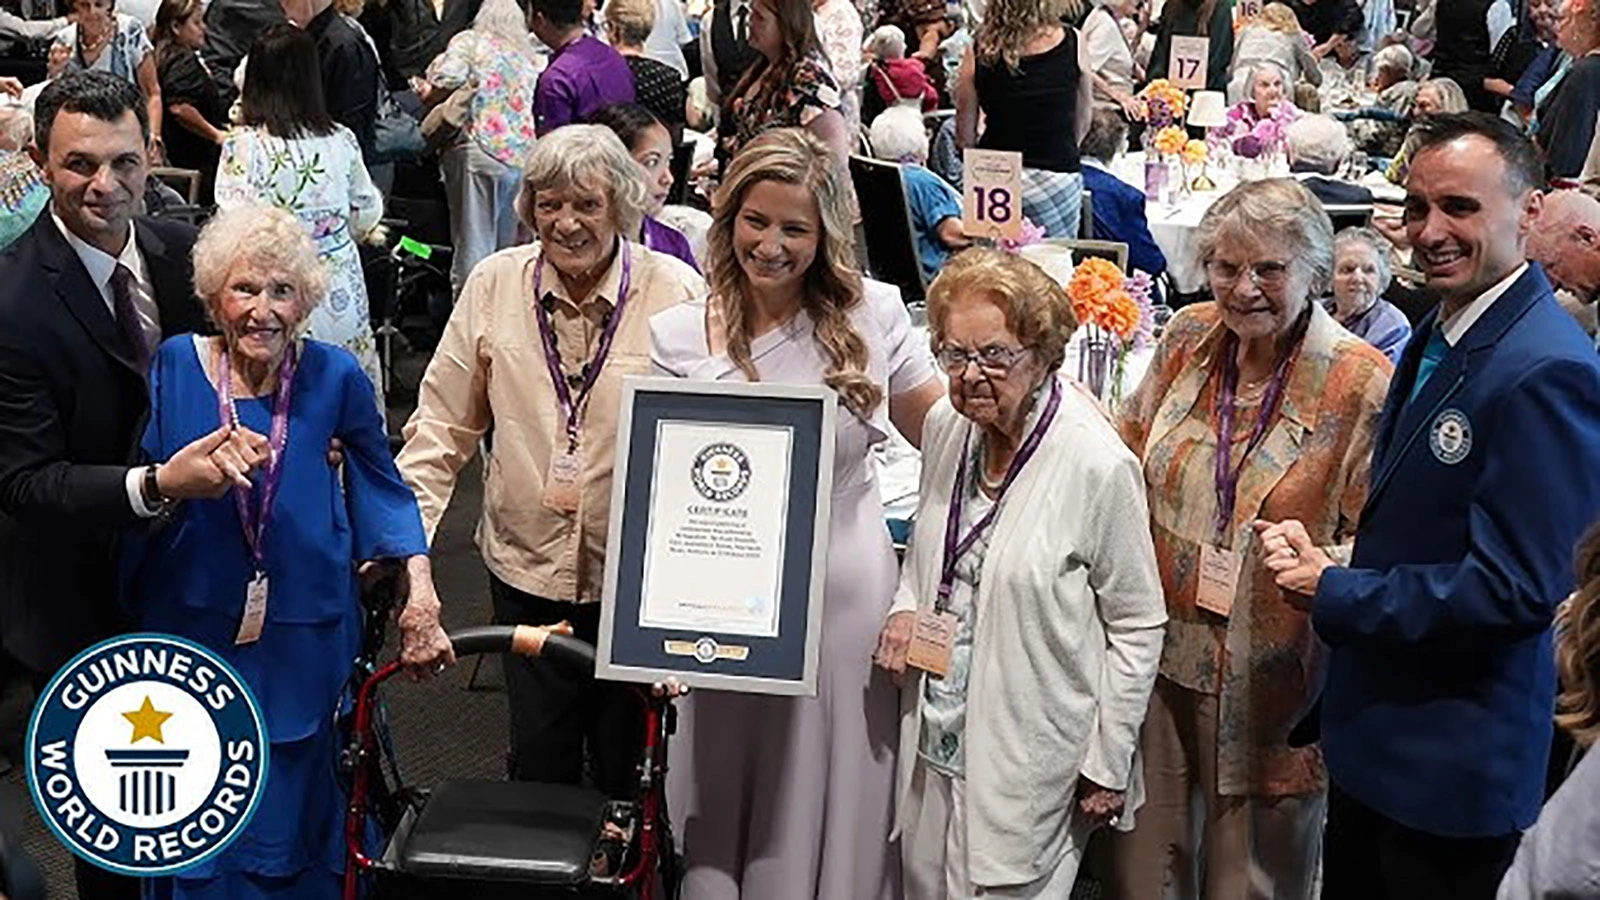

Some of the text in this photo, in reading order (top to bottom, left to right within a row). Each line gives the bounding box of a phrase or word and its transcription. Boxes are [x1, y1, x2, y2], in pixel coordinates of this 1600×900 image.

[1241, 2, 1258, 16] 16
[1177, 58, 1200, 79] 17
[973, 186, 1011, 223] 18
